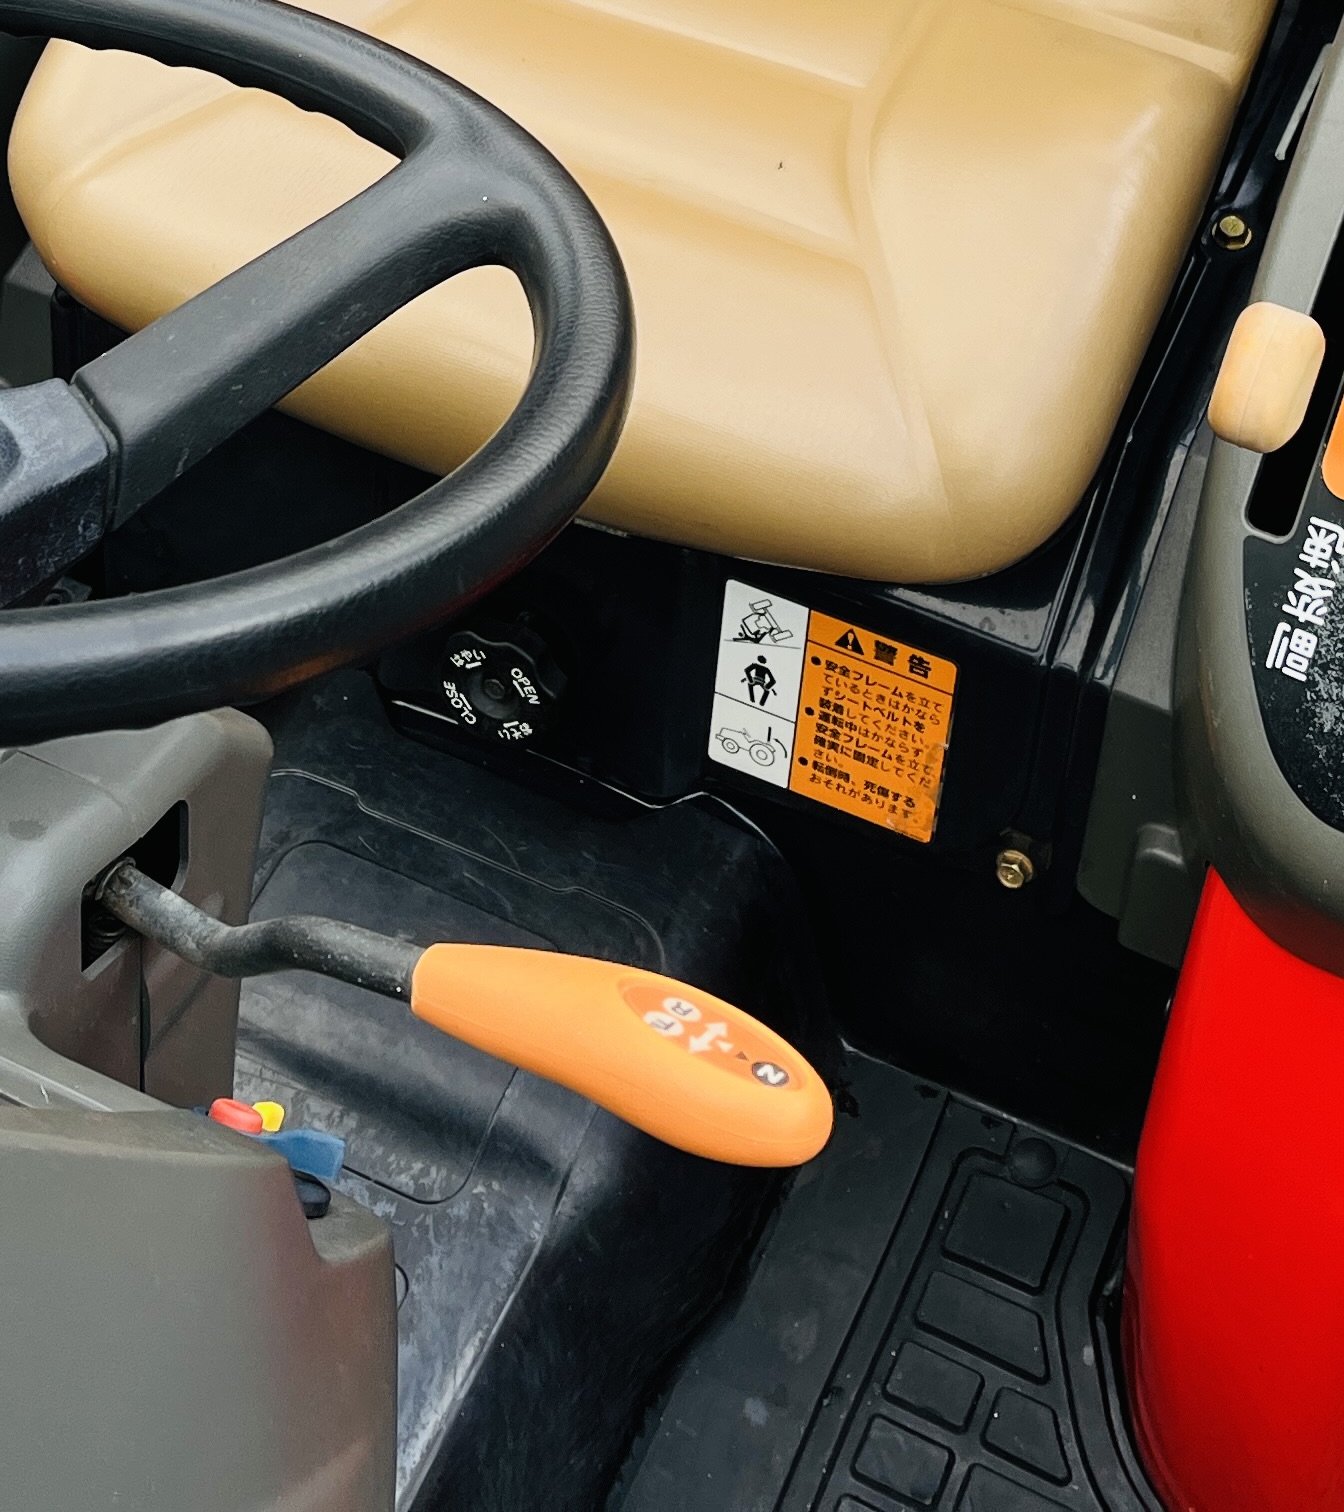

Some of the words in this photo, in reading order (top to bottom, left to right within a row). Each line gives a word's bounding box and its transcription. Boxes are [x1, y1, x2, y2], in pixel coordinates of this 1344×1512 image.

[450, 649, 486, 667] はやい
[872, 638, 933, 680] 警告
[443, 681, 476, 724] CLOSE
[511, 667, 540, 704] OPEN
[820, 685, 926, 734] ずシートベルトを
[822, 672, 941, 726] ているときはかなら
[823, 659, 944, 714] 安全フレームを立て
[498, 722, 533, 740] おそい
[817, 709, 924, 760] 運転中はかならず
[818, 697, 931, 750] 装着してください。
[812, 747, 845, 769] さい。
[812, 735, 931, 789] 確実に固定してくだ
[808, 771, 919, 823] おそれがあります。
